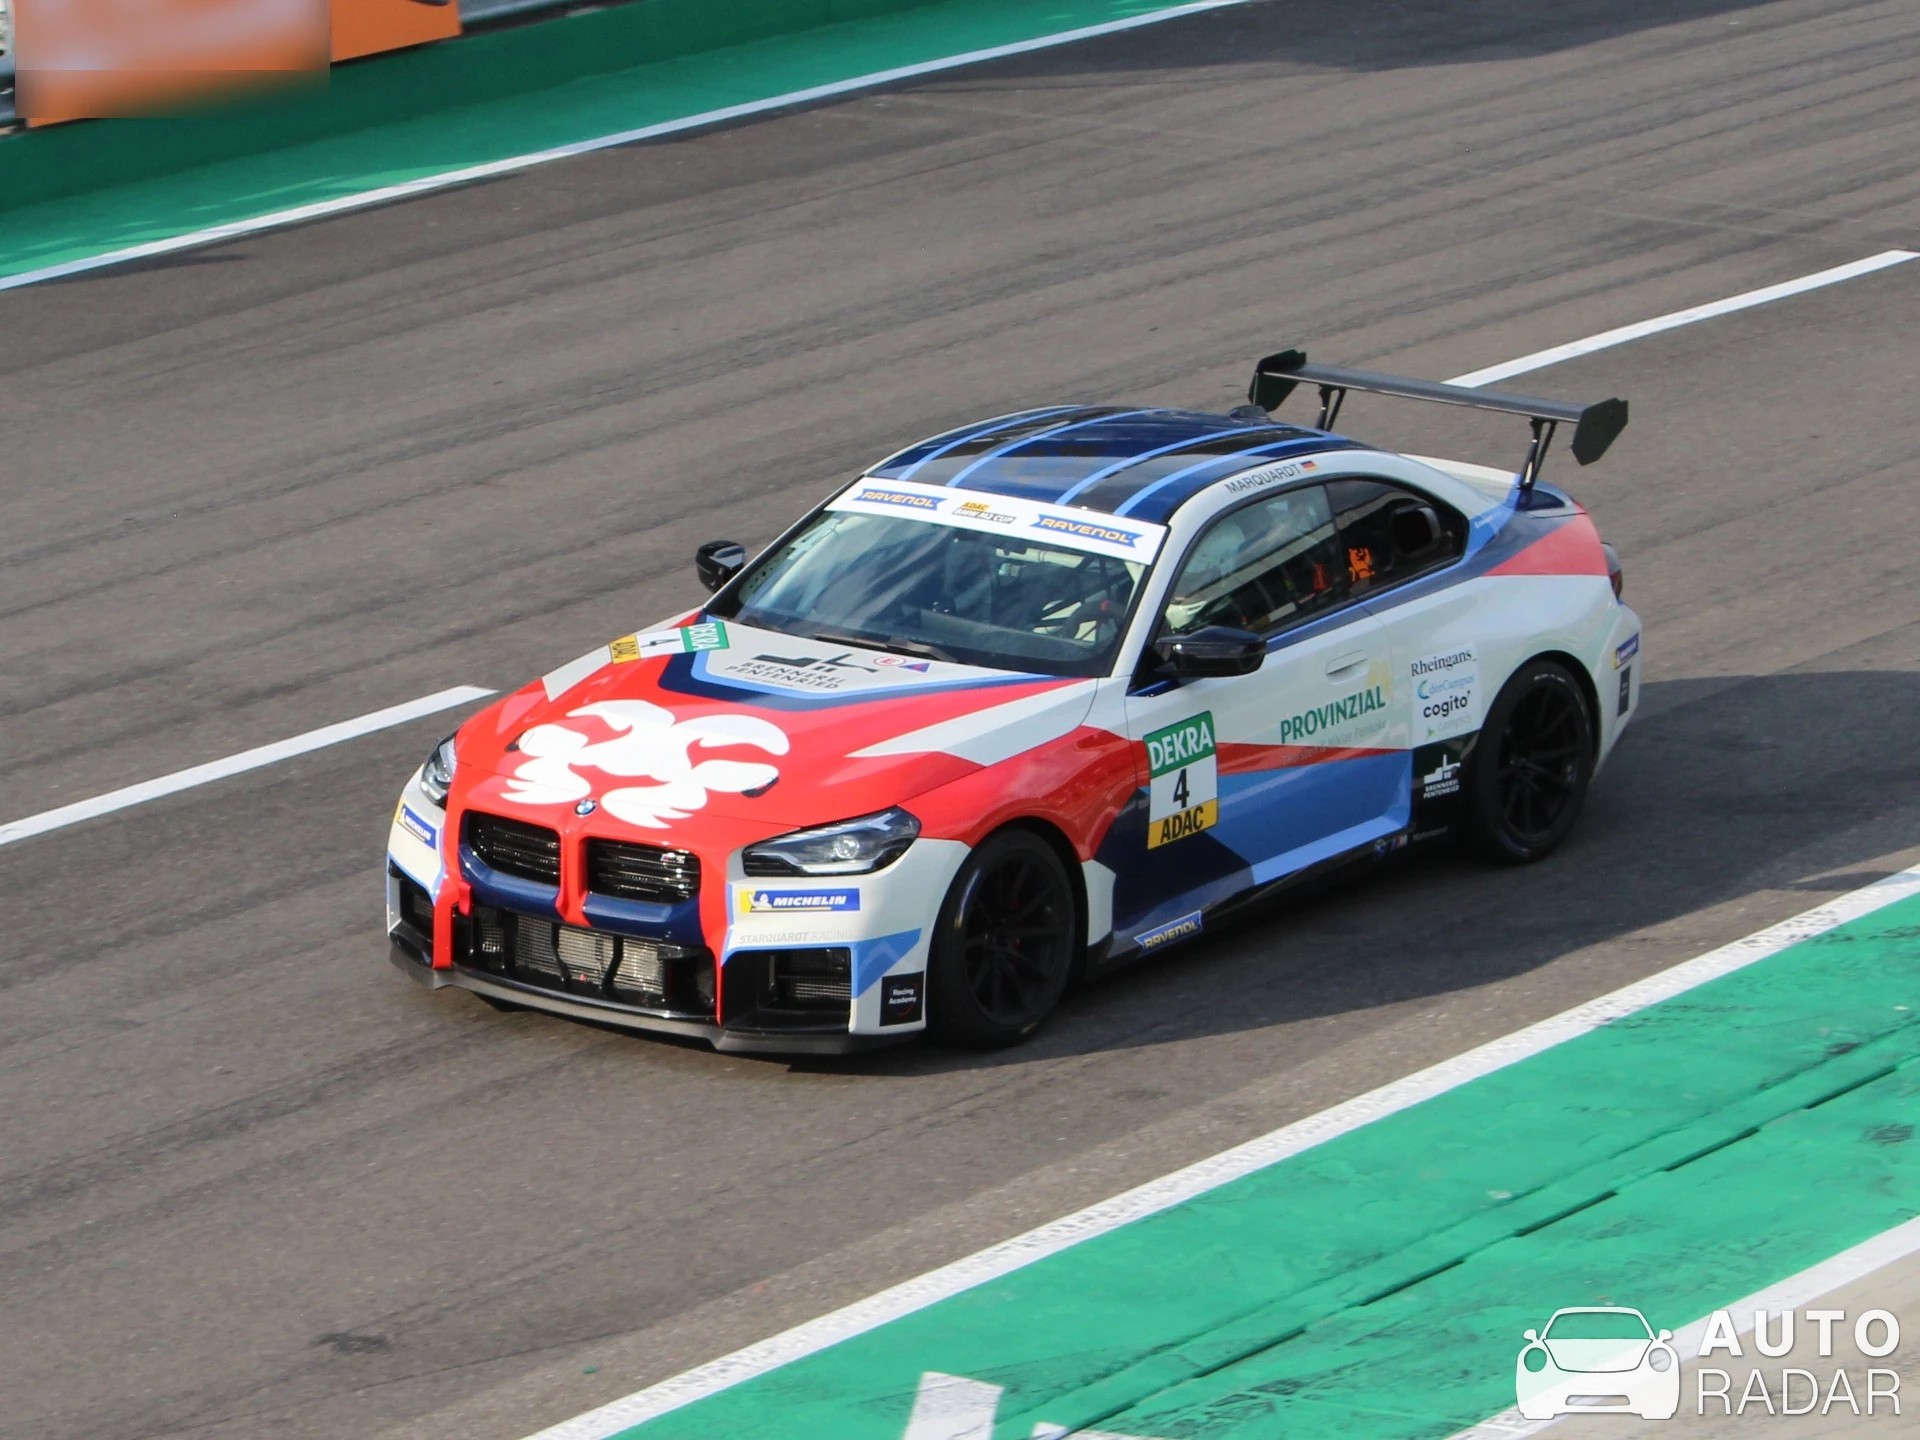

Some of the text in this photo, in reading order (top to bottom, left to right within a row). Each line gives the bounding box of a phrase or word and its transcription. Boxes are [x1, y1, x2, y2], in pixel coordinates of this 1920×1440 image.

[1224, 464, 1301, 493] MARQUARDT
[862, 490, 937, 508] RAVENOL
[961, 502, 989, 511] ADAC
[994, 514, 1015, 523] CUP
[1040, 518, 1131, 544] RAVENOL
[640, 637, 681, 648] 4
[688, 623, 721, 651] DEKRA
[724, 665, 840, 689] PENTENRIED
[741, 661, 847, 685] BRENNEREI
[1280, 686, 1386, 744] PROVINZIAL
[1147, 721, 1214, 771] DEKRA
[1173, 768, 1190, 809] 4
[1423, 785, 1460, 799] PENTENRIED
[1425, 779, 1459, 792] BRENNEREI
[1160, 806, 1204, 844] ADAC
[773, 895, 847, 906] MICHELIN
[739, 929, 853, 944] STARQUARDT RACING
[1144, 920, 1198, 949] RAVENOL
[889, 995, 917, 1005] Academy
[892, 988, 915, 997] Racing
